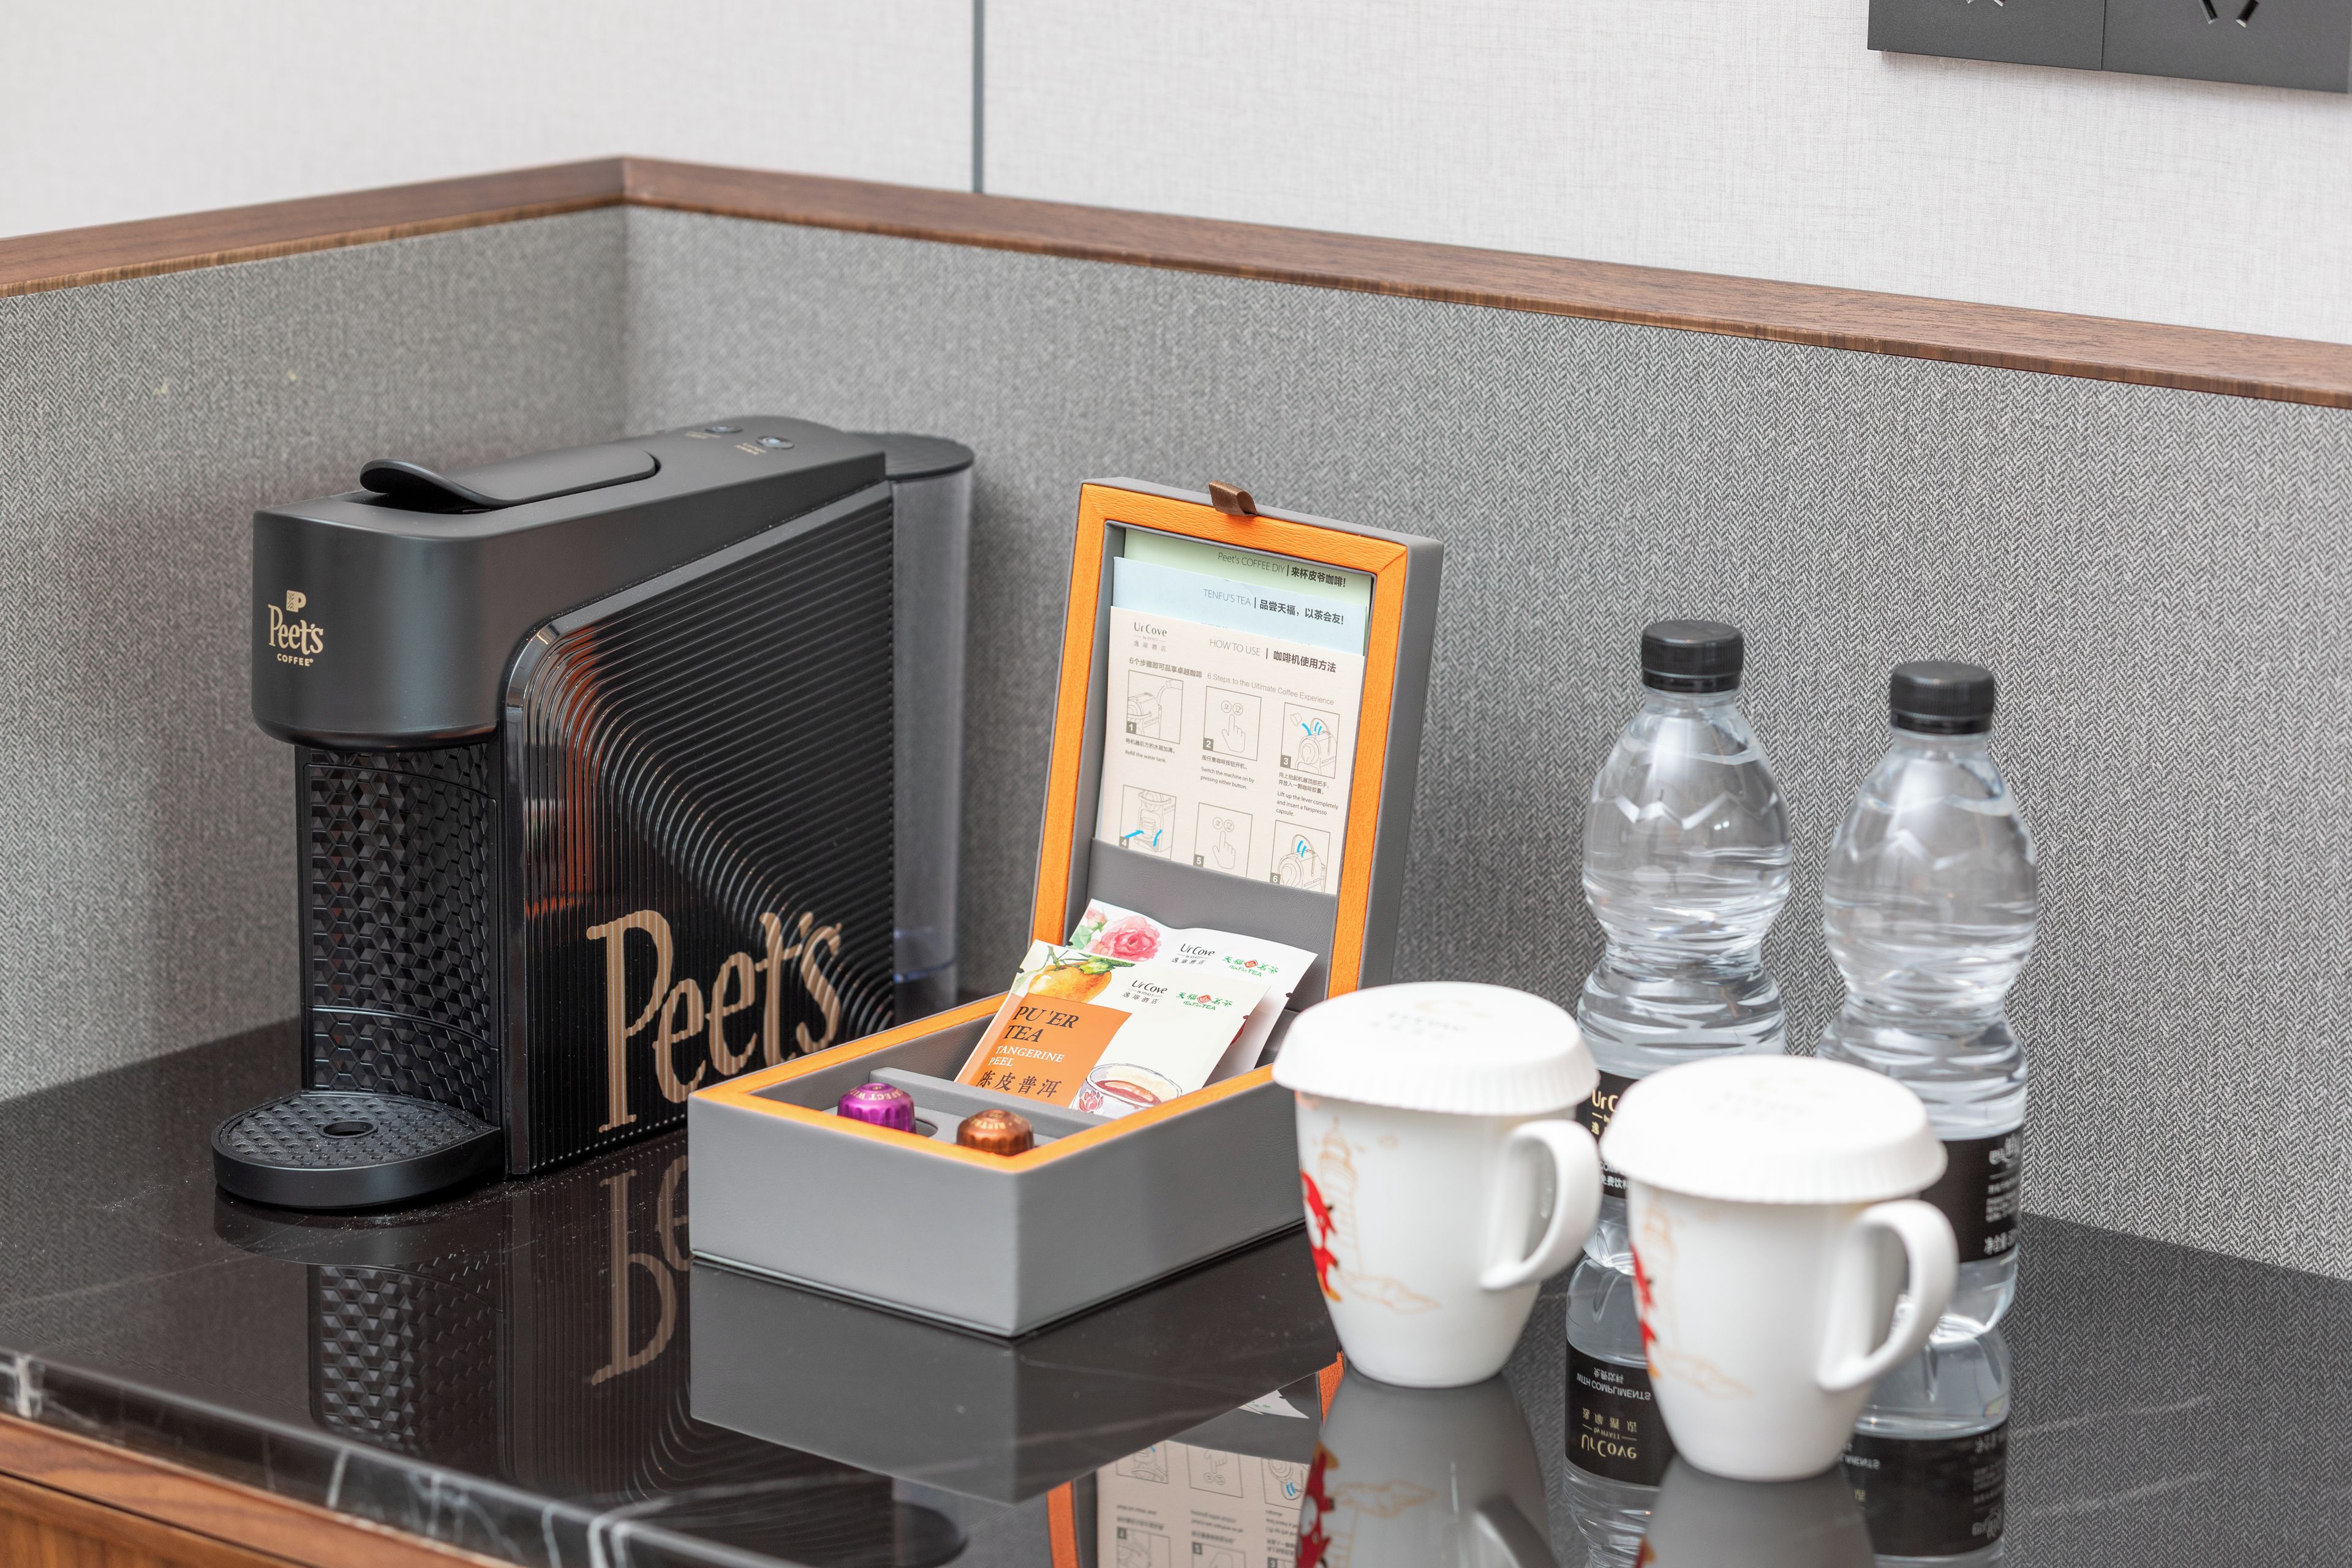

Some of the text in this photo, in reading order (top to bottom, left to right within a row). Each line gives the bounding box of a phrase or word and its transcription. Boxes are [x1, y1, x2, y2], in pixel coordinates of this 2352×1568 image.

[1218, 552, 1286, 573] Peet's COFFEE DIY
[1291, 567, 1346, 587] 来杯皮爷咖啡!
[1203, 589, 1251, 606] TENFU'S TEA
[268, 604, 323, 655] Peet's
[1134, 622, 1167, 637] UrCove
[1210, 638, 1261, 656] HOW TO USE
[1273, 650, 1336, 673] 咖啡机使用方法
[1213, 674, 1231, 684] Steps
[1240, 679, 1250, 688] the
[1251, 682, 1276, 693] Ultimate
[1278, 687, 1298, 698] Coffee
[1299, 692, 1335, 706] Experience
[1200, 775, 1218, 784] pressing
[1276, 808, 1294, 816] capsule.
[1304, 805, 1327, 816] Nespresso
[1313, 799, 1339, 810] completely
[1121, 839, 1127, 847] 4
[1180, 943, 1215, 956] UrCove
[1248, 968, 1262, 977] TEA
[1132, 980, 1167, 993] UrCove
[586, 909, 843, 1133] Peet's
[1003, 1025, 1044, 1042] TEA
[987, 1057, 1014, 1066] PEEL
[995, 1045, 1065, 1063] TANGERINE
[976, 1070, 1062, 1098] 陈皮普洱
[1592, 1088, 1618, 1113] UrC
